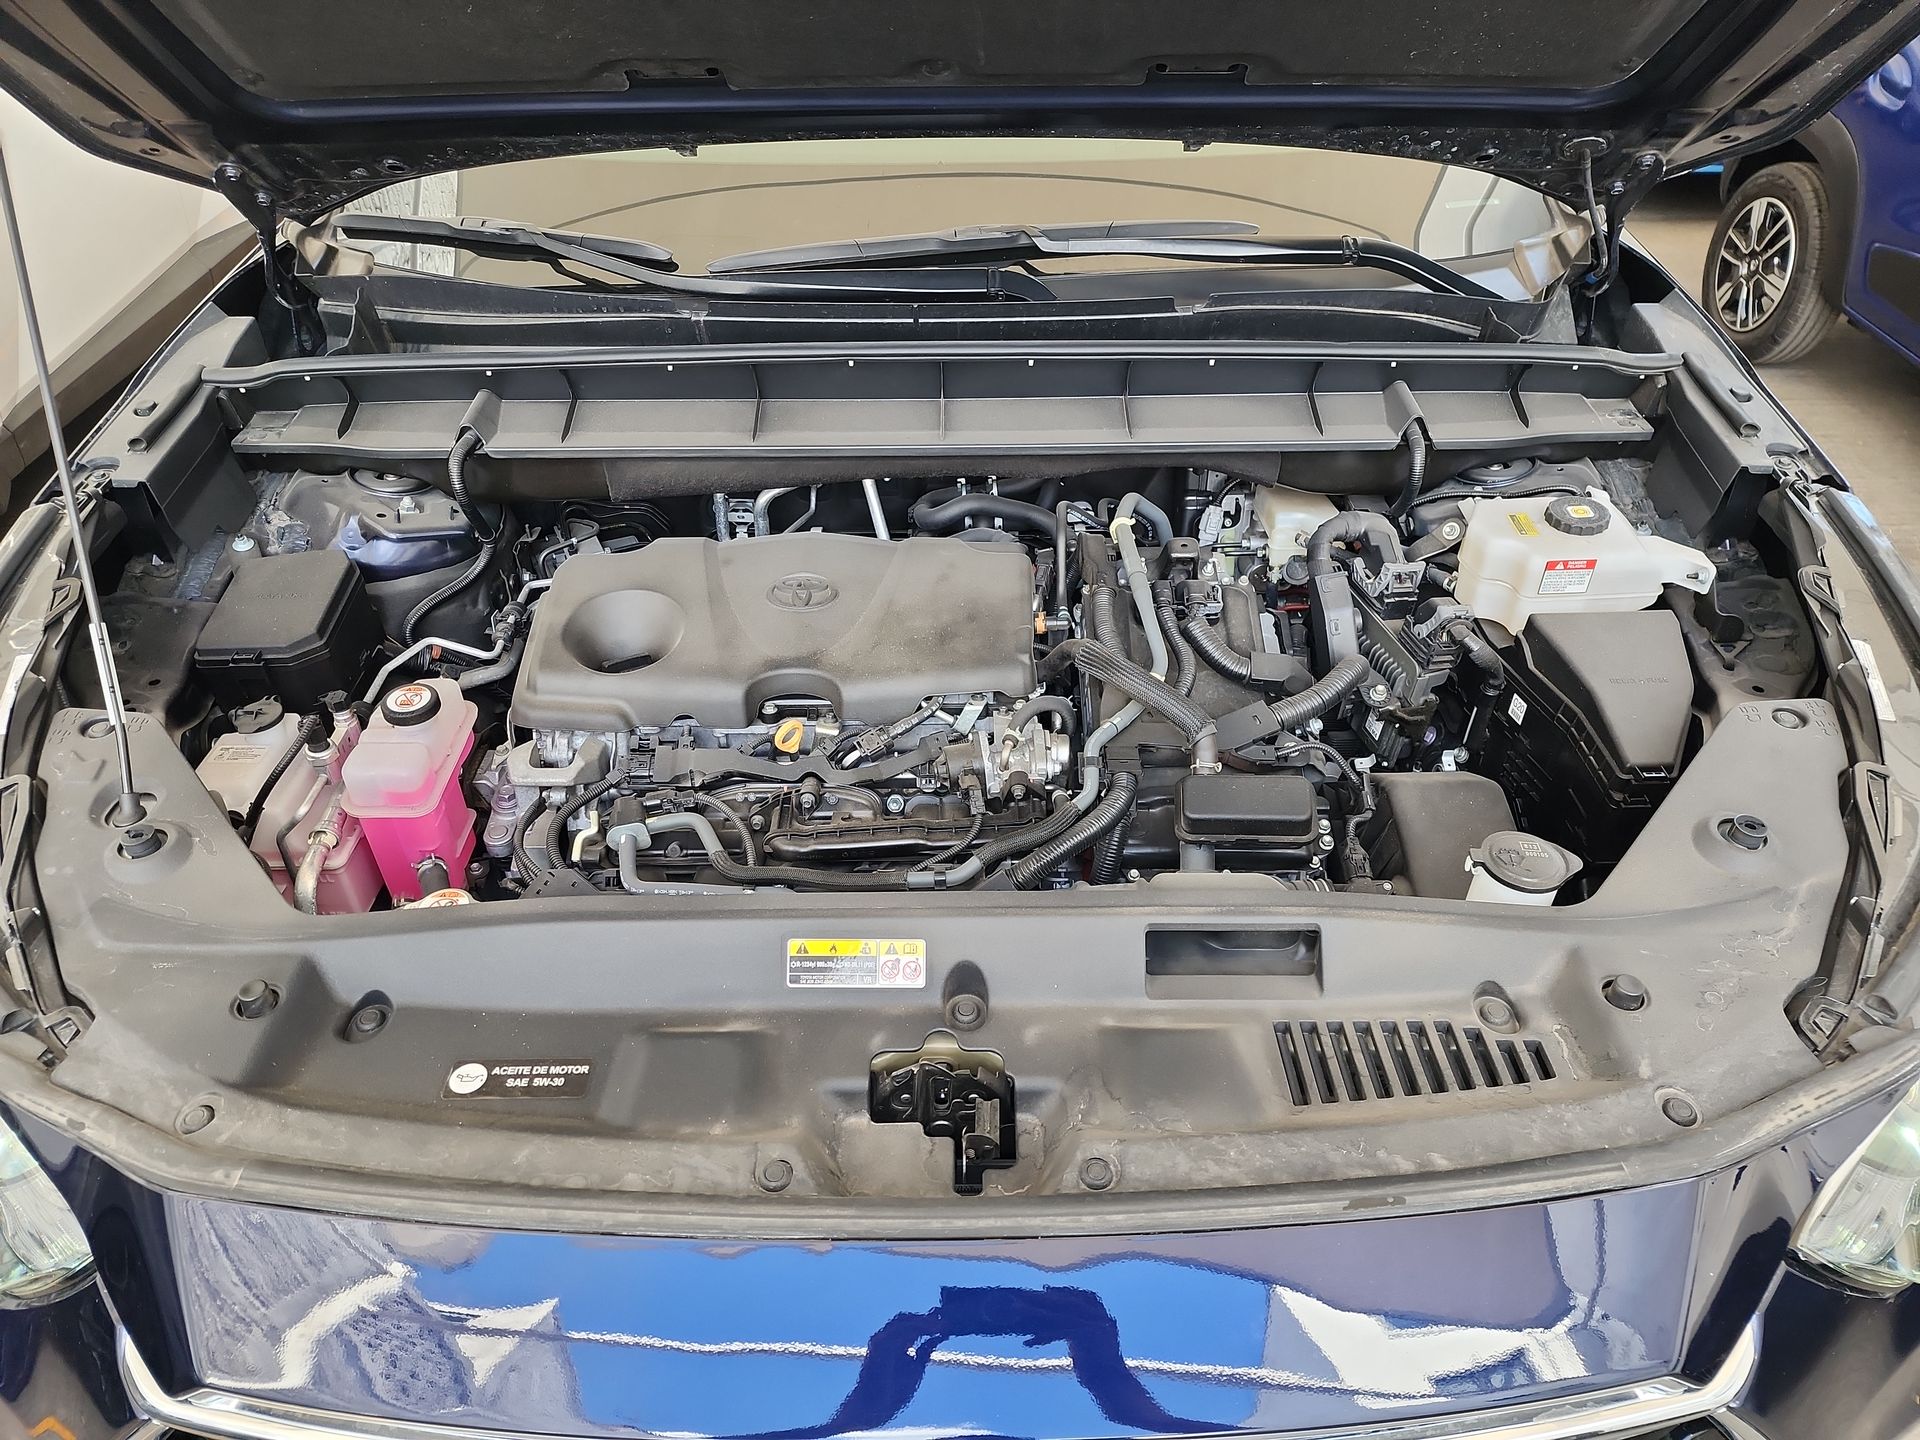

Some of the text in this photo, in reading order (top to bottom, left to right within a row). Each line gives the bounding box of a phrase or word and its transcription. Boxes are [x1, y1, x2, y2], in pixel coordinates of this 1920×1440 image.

[491, 1065, 590, 1076] ACEITE DE MOTOR
[505, 1077, 565, 1087] SAE 5W-30
